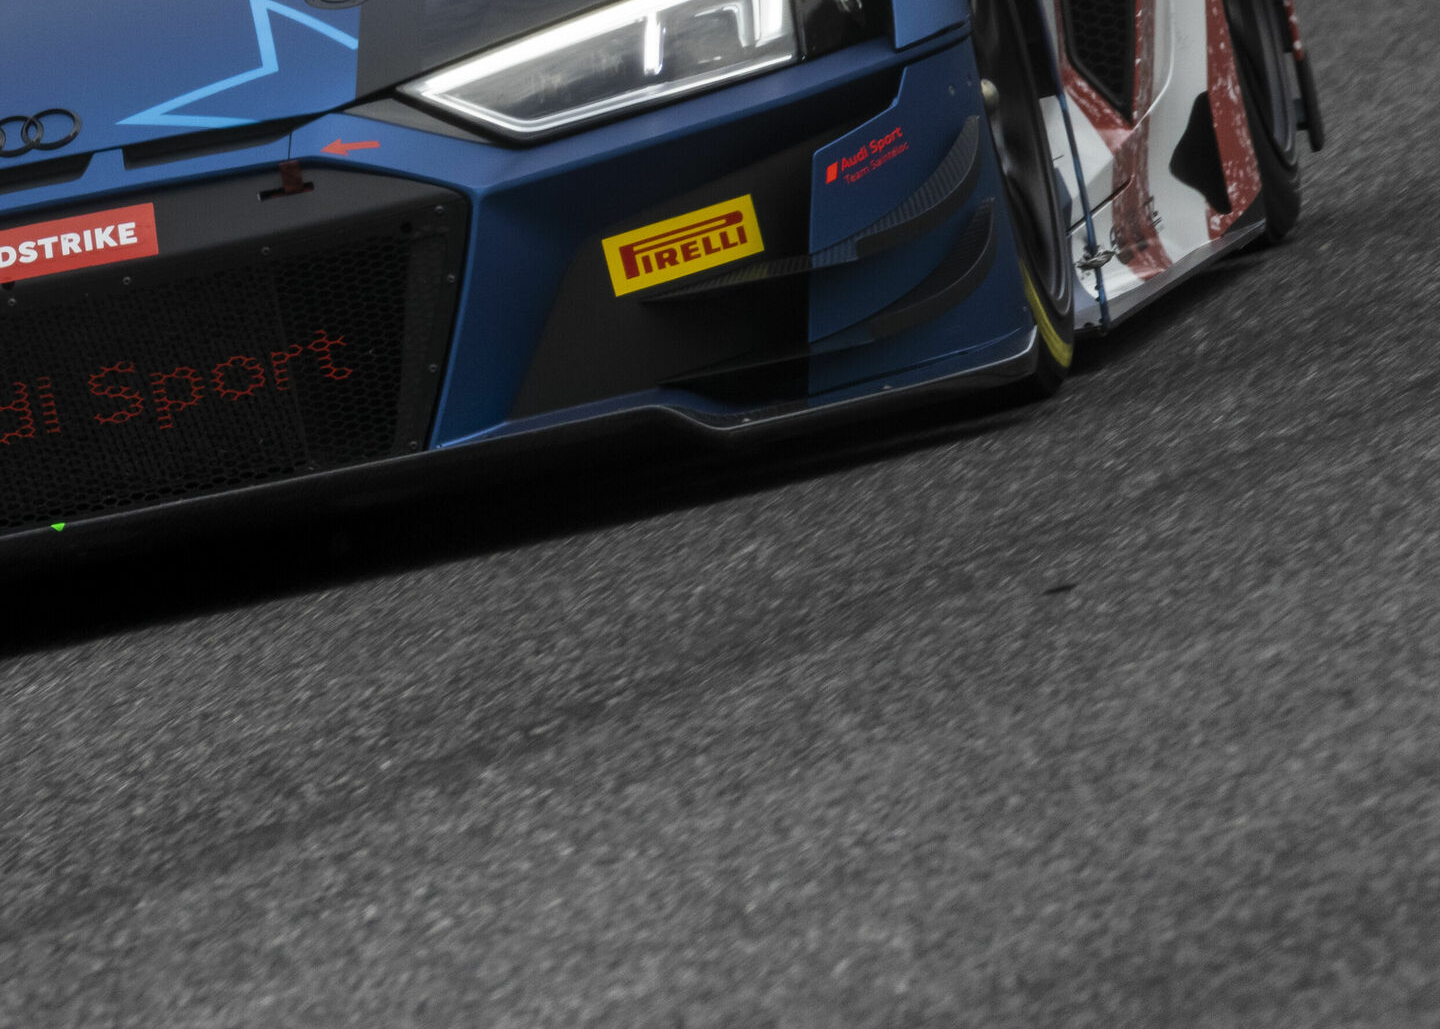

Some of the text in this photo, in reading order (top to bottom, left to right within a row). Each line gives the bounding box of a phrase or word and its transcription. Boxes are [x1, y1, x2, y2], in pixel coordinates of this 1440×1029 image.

[840, 126, 903, 172] Audi Sport
[618, 208, 749, 280] PIRELLI
[86, 328, 356, 430] Sport
